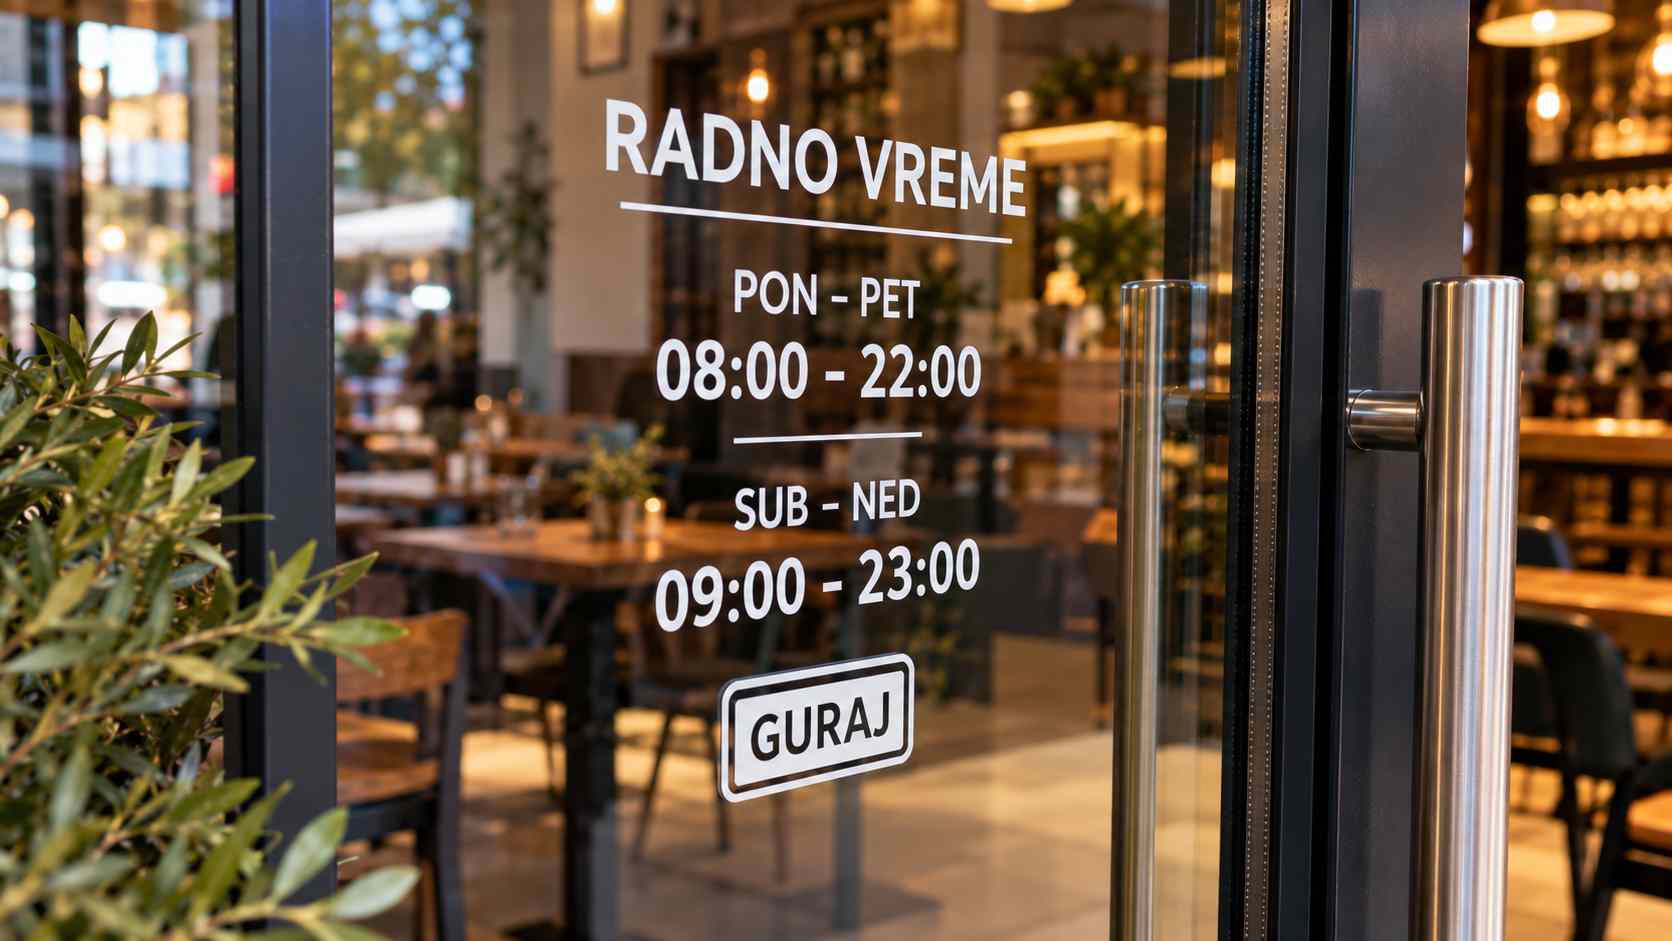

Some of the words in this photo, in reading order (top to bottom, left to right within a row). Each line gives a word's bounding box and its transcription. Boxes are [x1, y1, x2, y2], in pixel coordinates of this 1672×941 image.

[605, 98, 838, 195] RADNO
[854, 135, 1026, 217] VREME
[734, 269, 818, 316] PON
[861, 276, 921, 321] PET
[655, 338, 809, 402] 08:00
[860, 343, 982, 399] 22:00
[734, 485, 809, 531] SUB
[852, 478, 921, 521] NED
[655, 556, 806, 632] 09:00
[858, 538, 981, 605] 23:00
[750, 691, 890, 761] GURAJ
